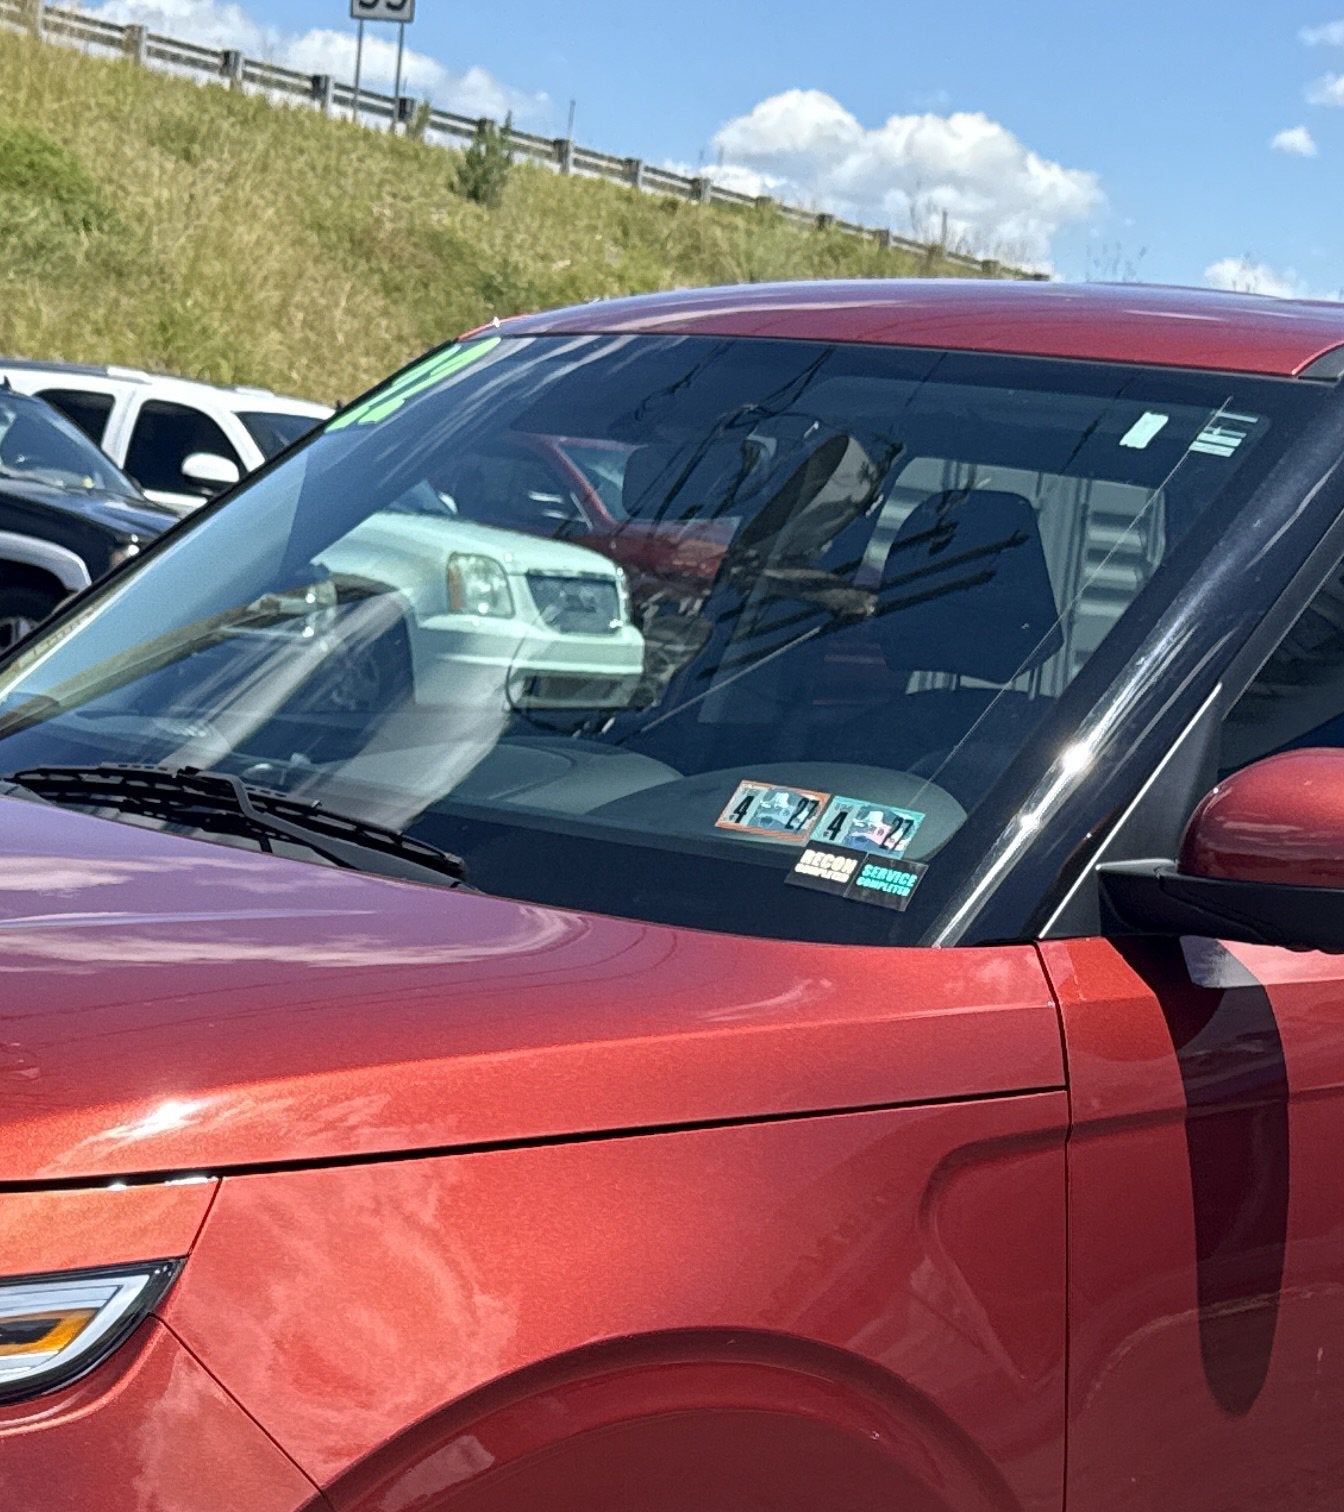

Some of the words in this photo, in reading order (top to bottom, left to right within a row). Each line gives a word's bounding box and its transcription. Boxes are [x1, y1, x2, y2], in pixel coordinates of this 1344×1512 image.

[733, 795, 755, 823] 4
[784, 797, 820, 833] 27
[827, 811, 849, 841] 4
[879, 816, 914, 853] 27
[799, 848, 858, 874] RECON
[861, 863, 918, 887] SERVICE
